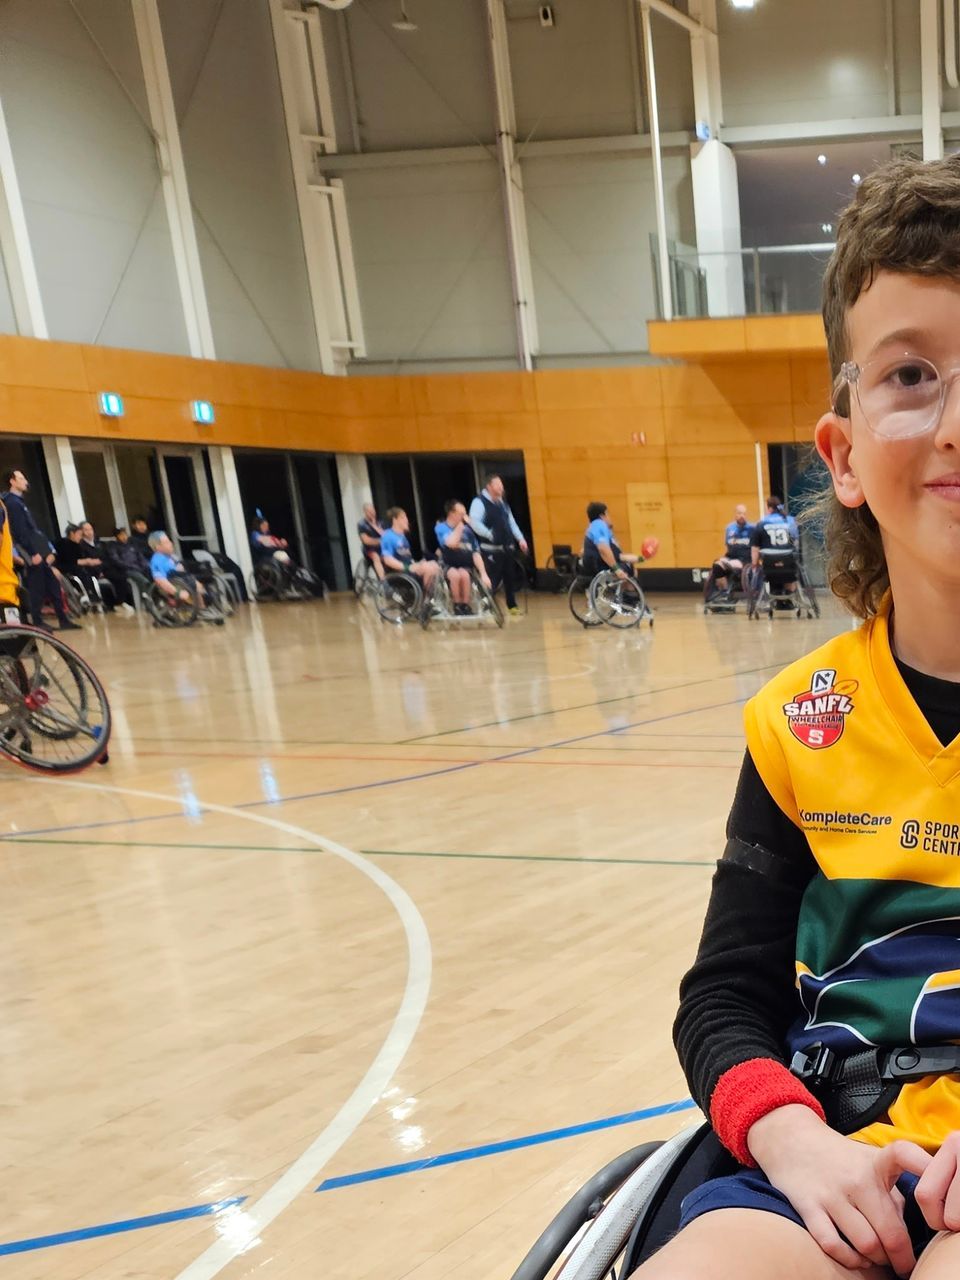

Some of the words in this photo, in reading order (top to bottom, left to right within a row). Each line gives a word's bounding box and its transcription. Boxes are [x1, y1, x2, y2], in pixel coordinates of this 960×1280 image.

[767, 529, 788, 546] 13
[784, 694, 852, 716] SANFL
[791, 715, 843, 724] WHEELCHAIR
[799, 809, 892, 826] KompleteCare
